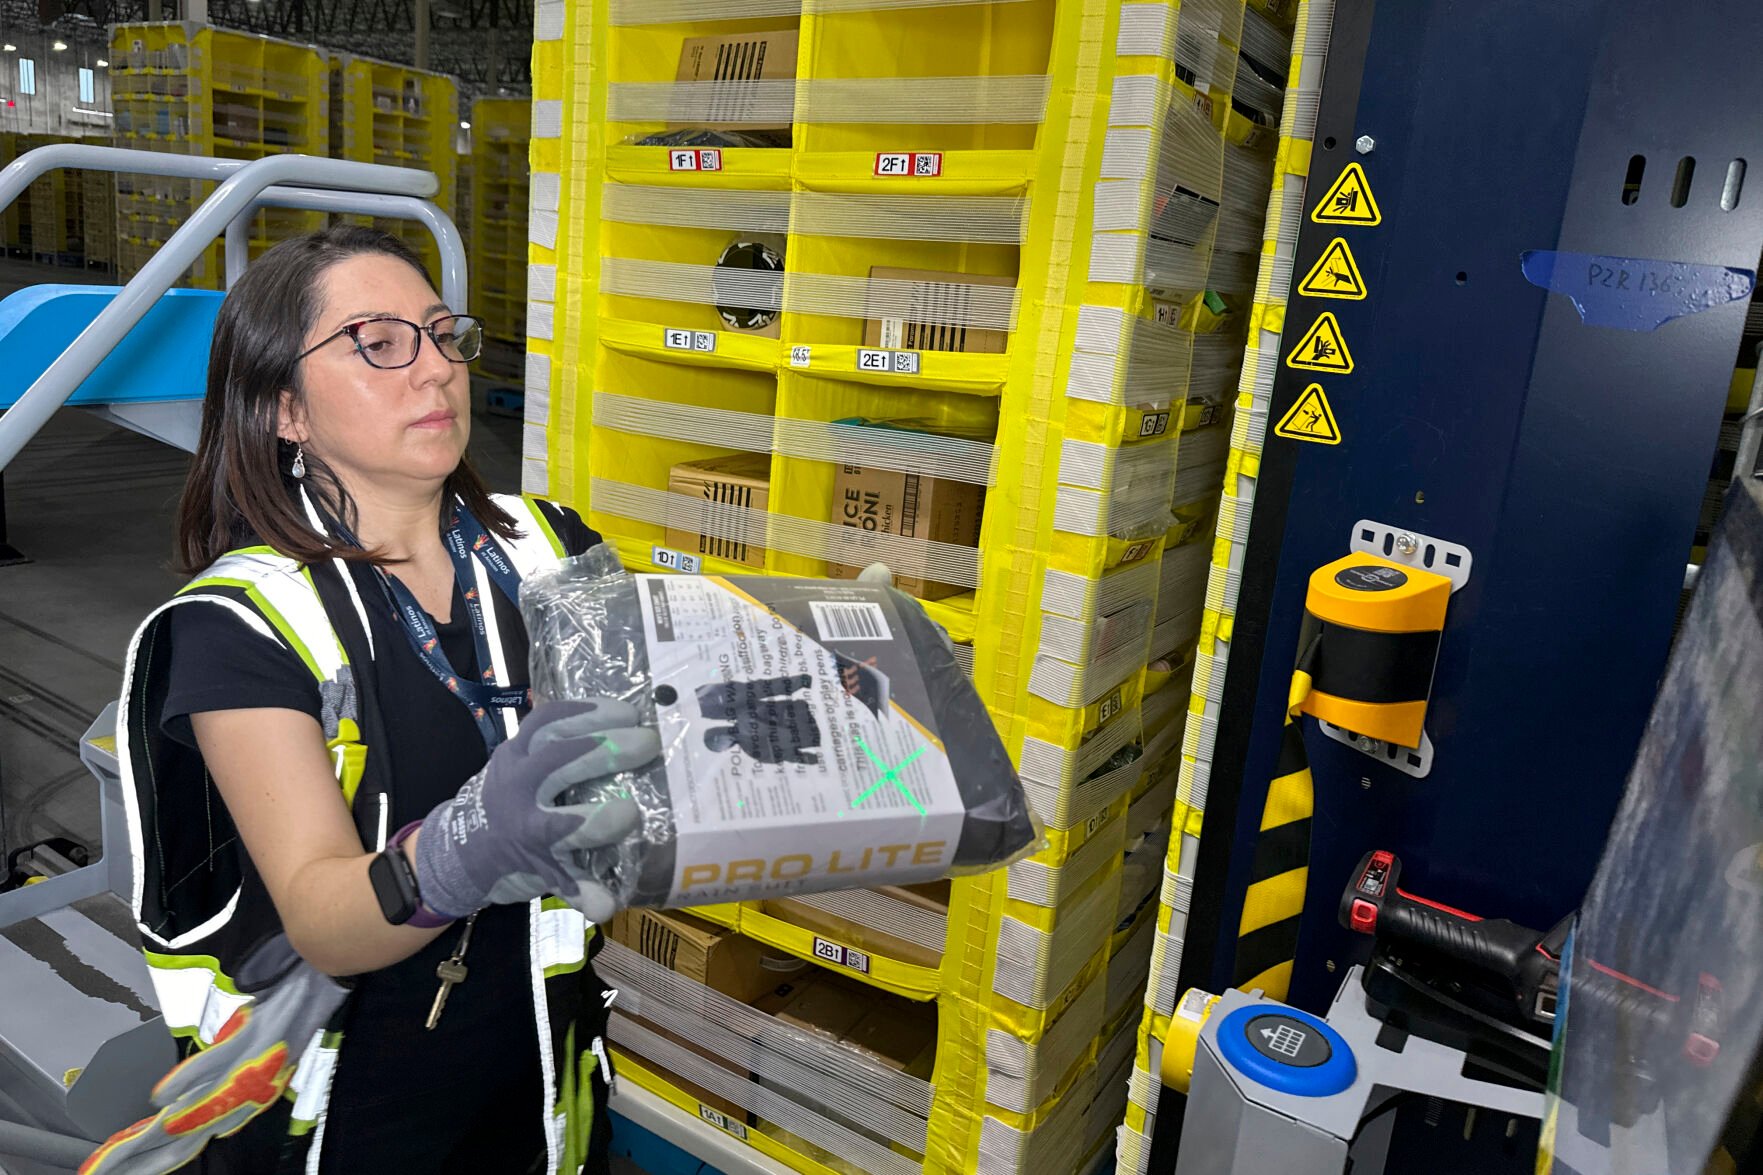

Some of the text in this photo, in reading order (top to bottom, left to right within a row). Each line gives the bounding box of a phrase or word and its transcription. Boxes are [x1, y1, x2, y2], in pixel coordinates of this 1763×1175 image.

[881, 157, 900, 172] 2F
[863, 353, 880, 368] 2E
[452, 529, 467, 560] Latinos
[486, 546, 511, 575] Latinos
[657, 551, 669, 564] 1D
[405, 605, 427, 638] Latinos
[473, 603, 486, 635] Latinos
[490, 696, 523, 704] Latinos
[681, 841, 947, 891] PRO LITE
[818, 942, 834, 957] 2B
